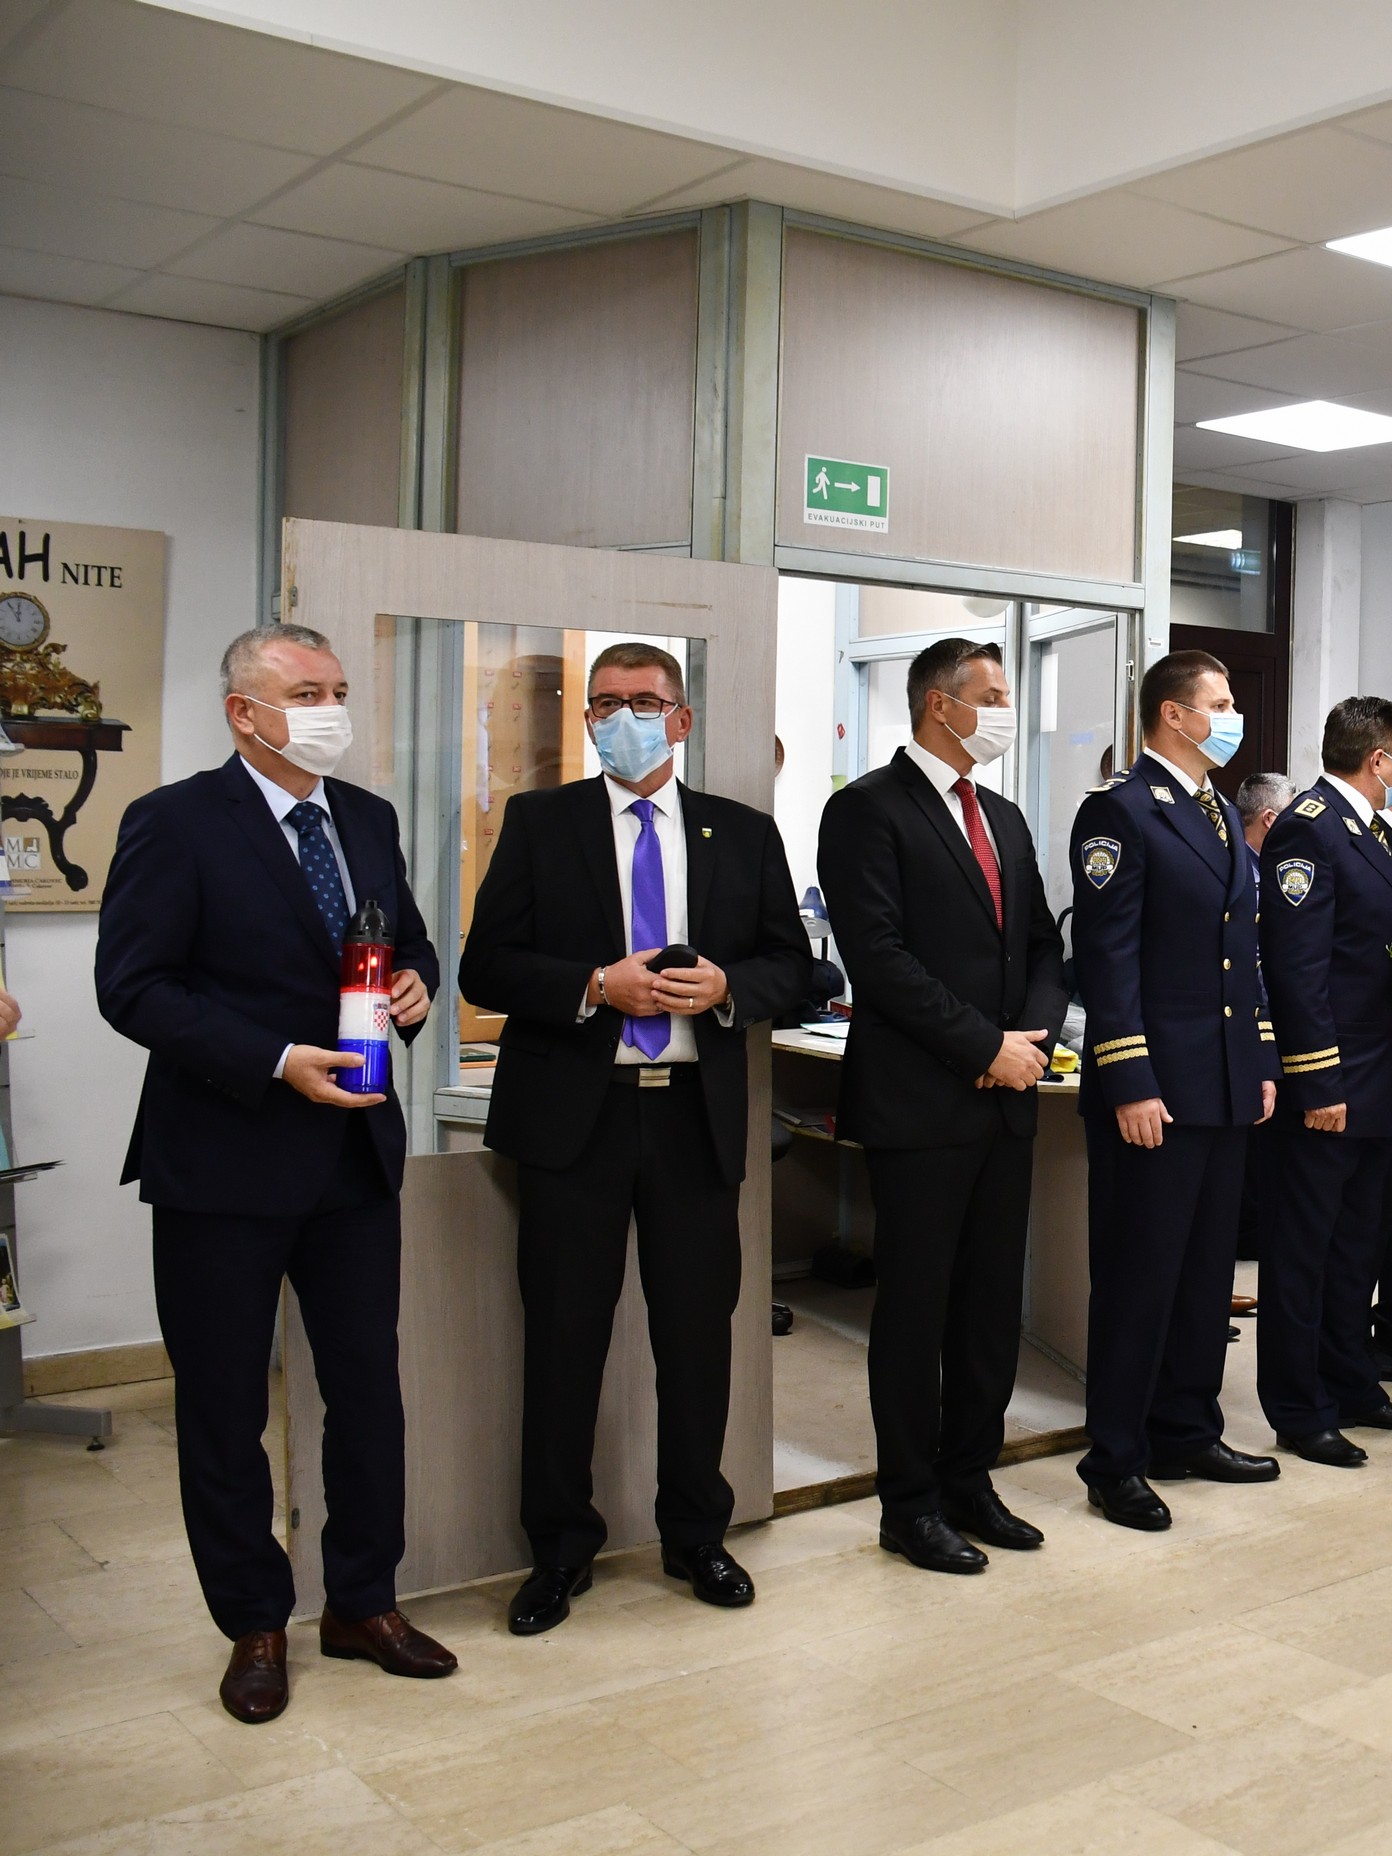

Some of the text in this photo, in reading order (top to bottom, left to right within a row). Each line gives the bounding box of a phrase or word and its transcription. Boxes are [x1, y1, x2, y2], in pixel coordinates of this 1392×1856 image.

[808, 513, 885, 529] EVAKUACIJSKI PUT
[60, 562, 122, 588] NITE
[12, 768, 20, 780] JE
[21, 768, 53, 780] VRIJEME
[54, 769, 79, 780] STALO
[1084, 840, 1118, 852] POLICIJA
[1279, 861, 1312, 872] POLICIJA
